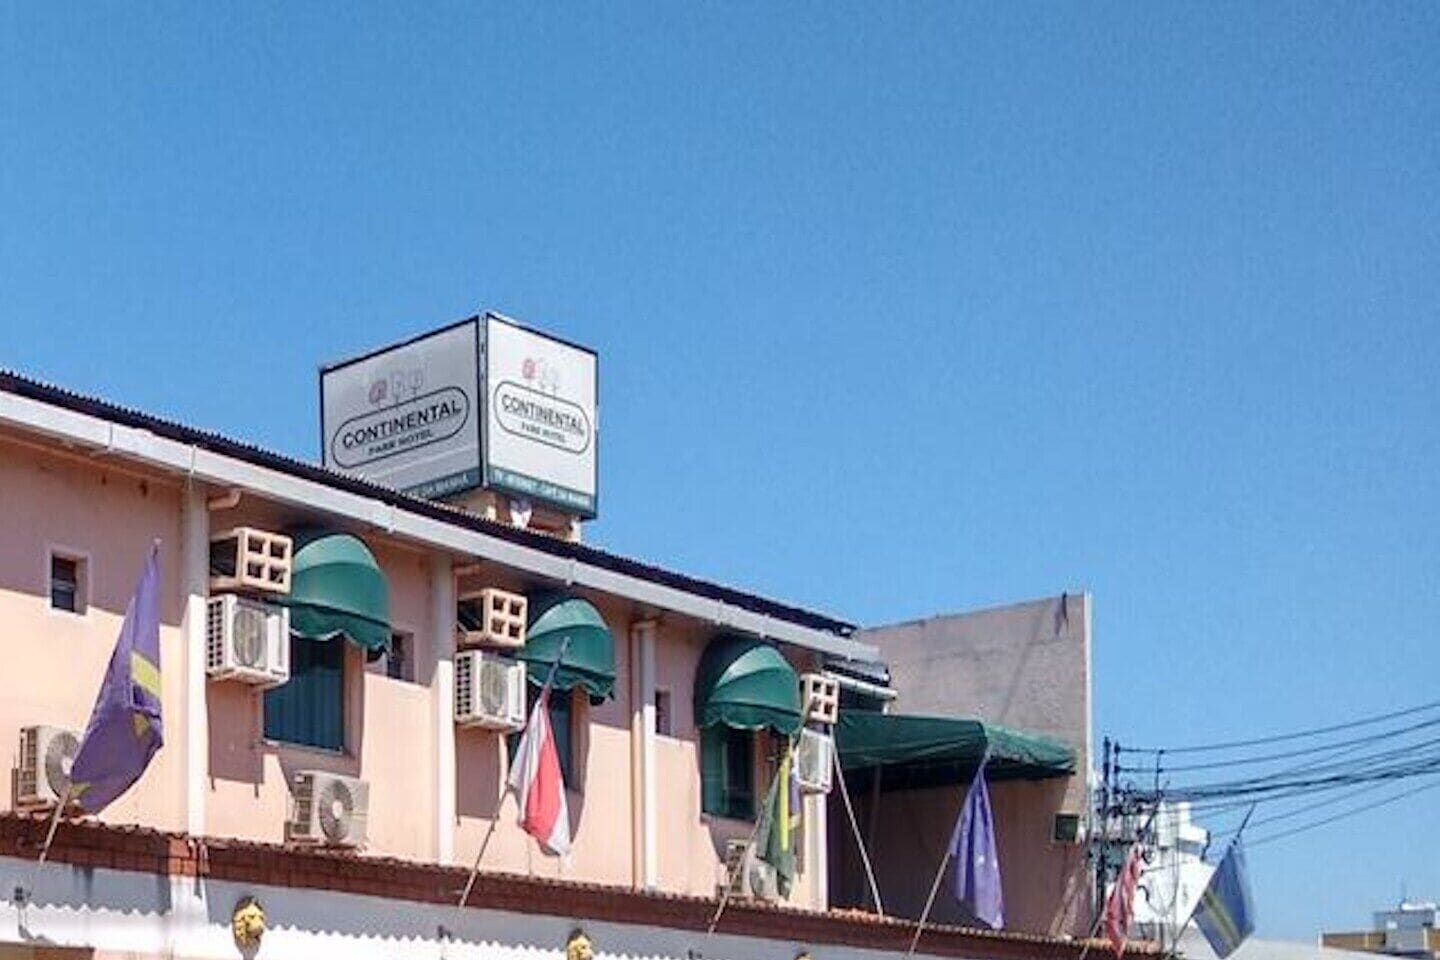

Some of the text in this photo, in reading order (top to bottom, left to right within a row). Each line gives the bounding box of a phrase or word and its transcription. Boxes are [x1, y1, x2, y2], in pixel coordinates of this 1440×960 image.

[342, 399, 462, 449] CONTINENTAL
[501, 394, 585, 438] CONTINENTAL
[368, 428, 433, 456] PARK HOTEL
